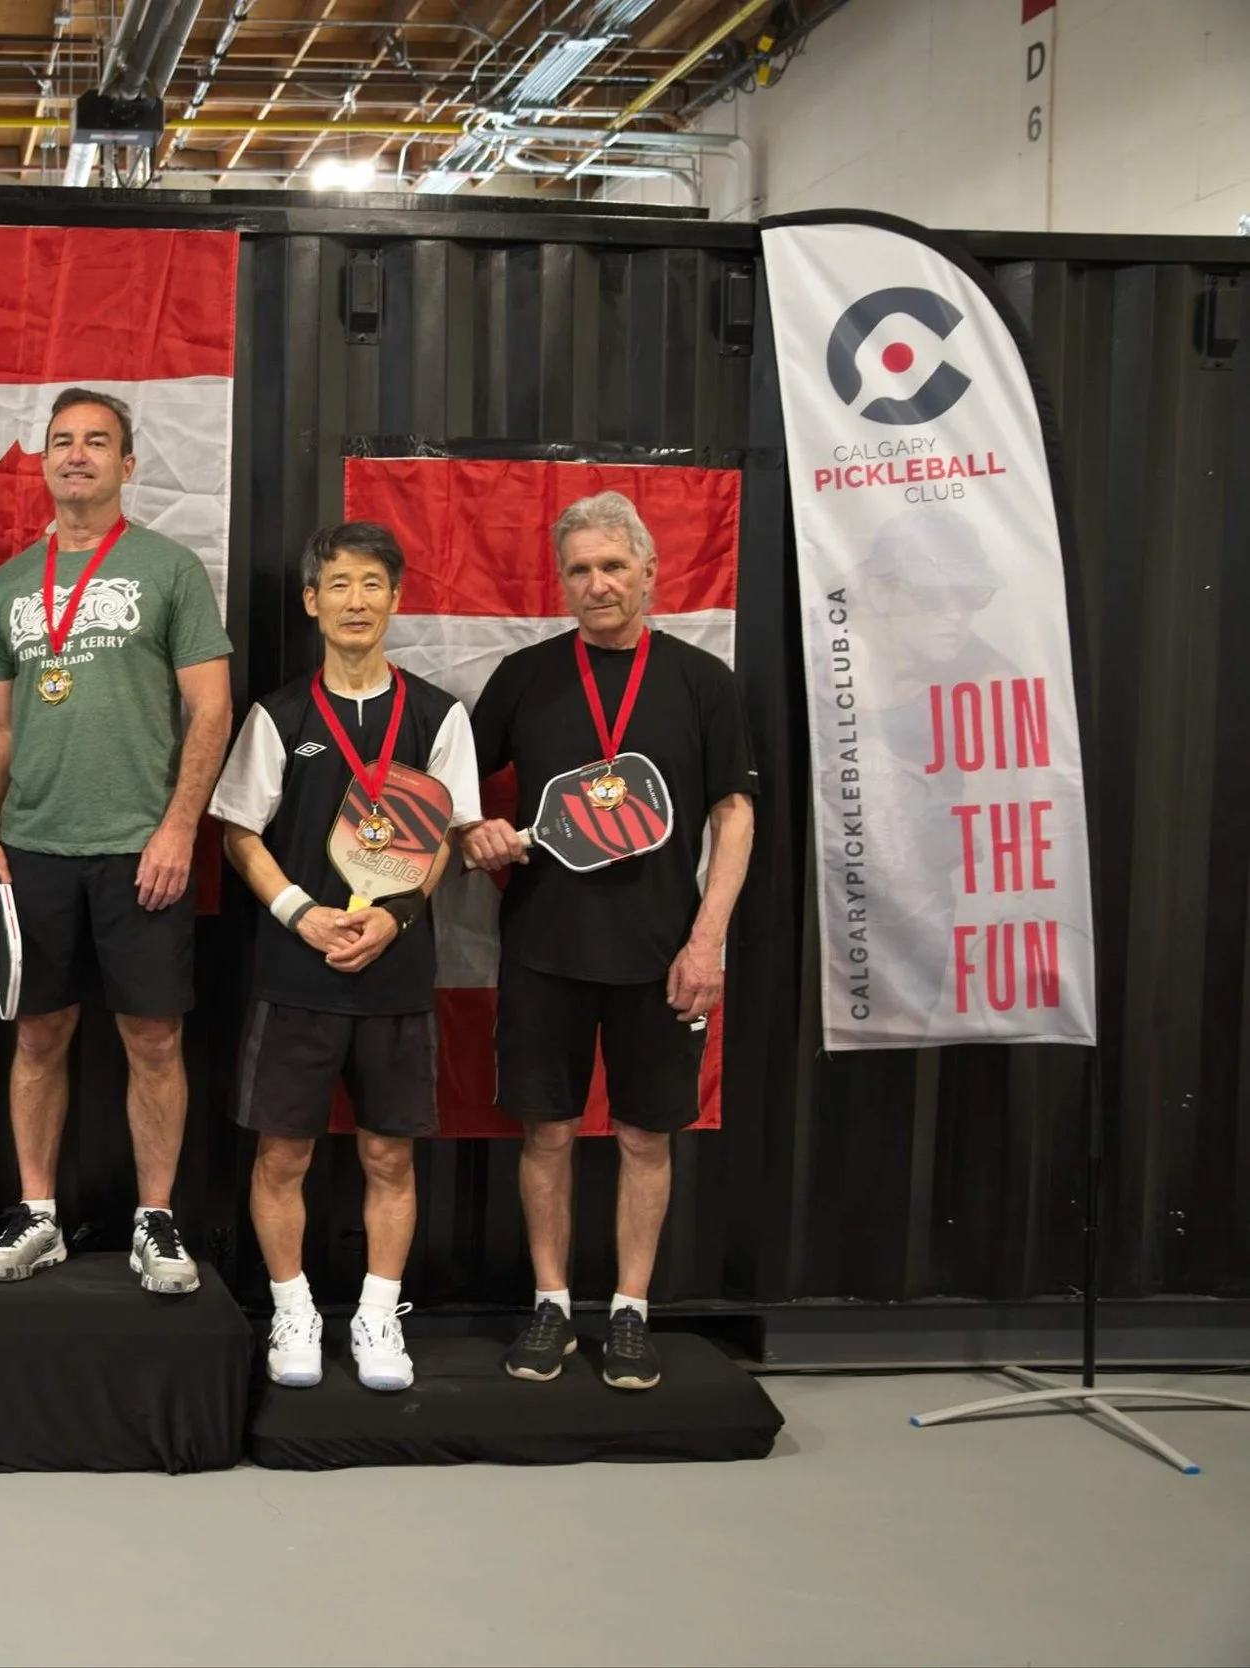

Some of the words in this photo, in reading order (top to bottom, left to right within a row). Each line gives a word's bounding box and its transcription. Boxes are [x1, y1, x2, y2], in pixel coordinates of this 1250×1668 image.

[1026, 41, 1046, 82] D
[1027, 105, 1042, 142] 6
[833, 437, 937, 463] CALGARY
[814, 452, 1007, 492] PICKLEBALL
[904, 483, 966, 503] CLUB
[80, 635, 127, 650] KERRY
[925, 677, 1050, 775] JOIN
[827, 587, 871, 1021] CALGARYPICKLEBALLCLUB.CA
[951, 800, 1056, 894] THE
[954, 920, 1060, 1013] FUN
